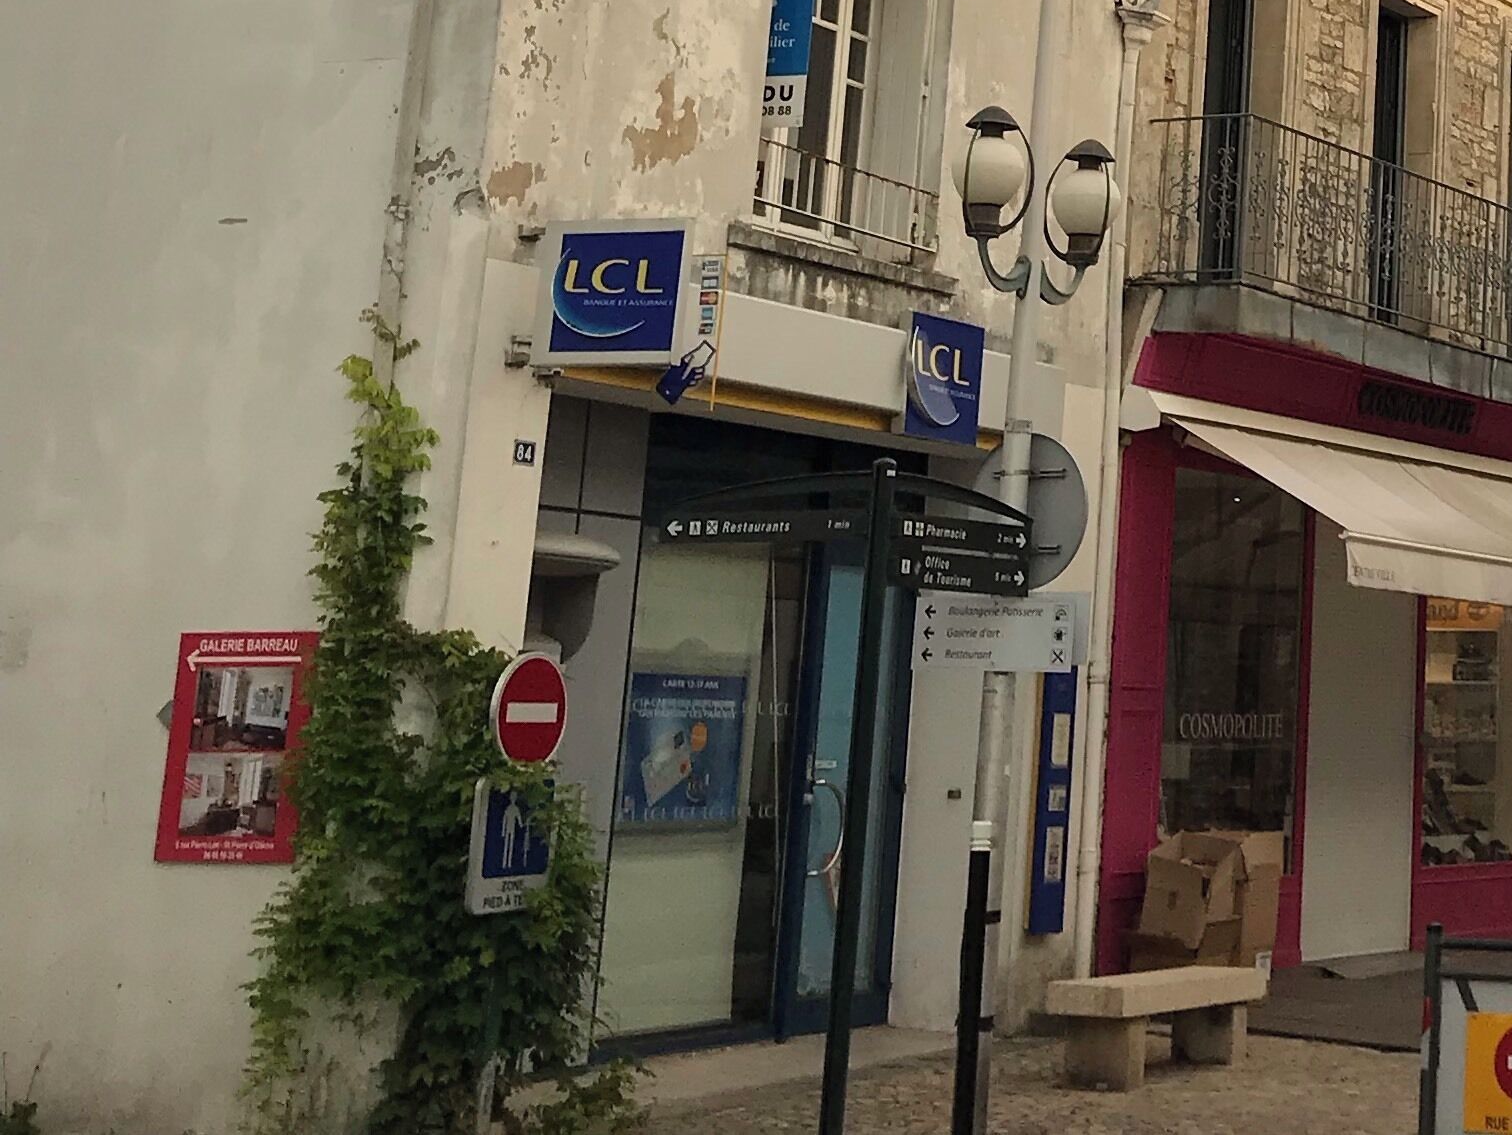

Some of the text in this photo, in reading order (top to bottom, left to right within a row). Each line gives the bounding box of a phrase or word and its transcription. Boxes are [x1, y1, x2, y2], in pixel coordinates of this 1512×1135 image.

[773, 19, 791, 31] de
[778, 106, 792, 116] 88
[564, 259, 663, 294] LCL
[917, 339, 970, 386] LCL
[516, 444, 532, 462] 84
[722, 520, 790, 534] Restaurants
[834, 521, 850, 530] min
[926, 524, 967, 540] Pharmacie
[925, 556, 950, 570] Office
[936, 572, 971, 587] Tourisme
[948, 606, 1000, 618] Boulangerie
[946, 628, 978, 638] Galerie
[200, 639, 298, 652] GALERIE BARREAU
[944, 649, 992, 659] Restaurant
[1180, 713, 1283, 739] COSMOPOLITE
[1485, 1116, 1509, 1130] RUE
